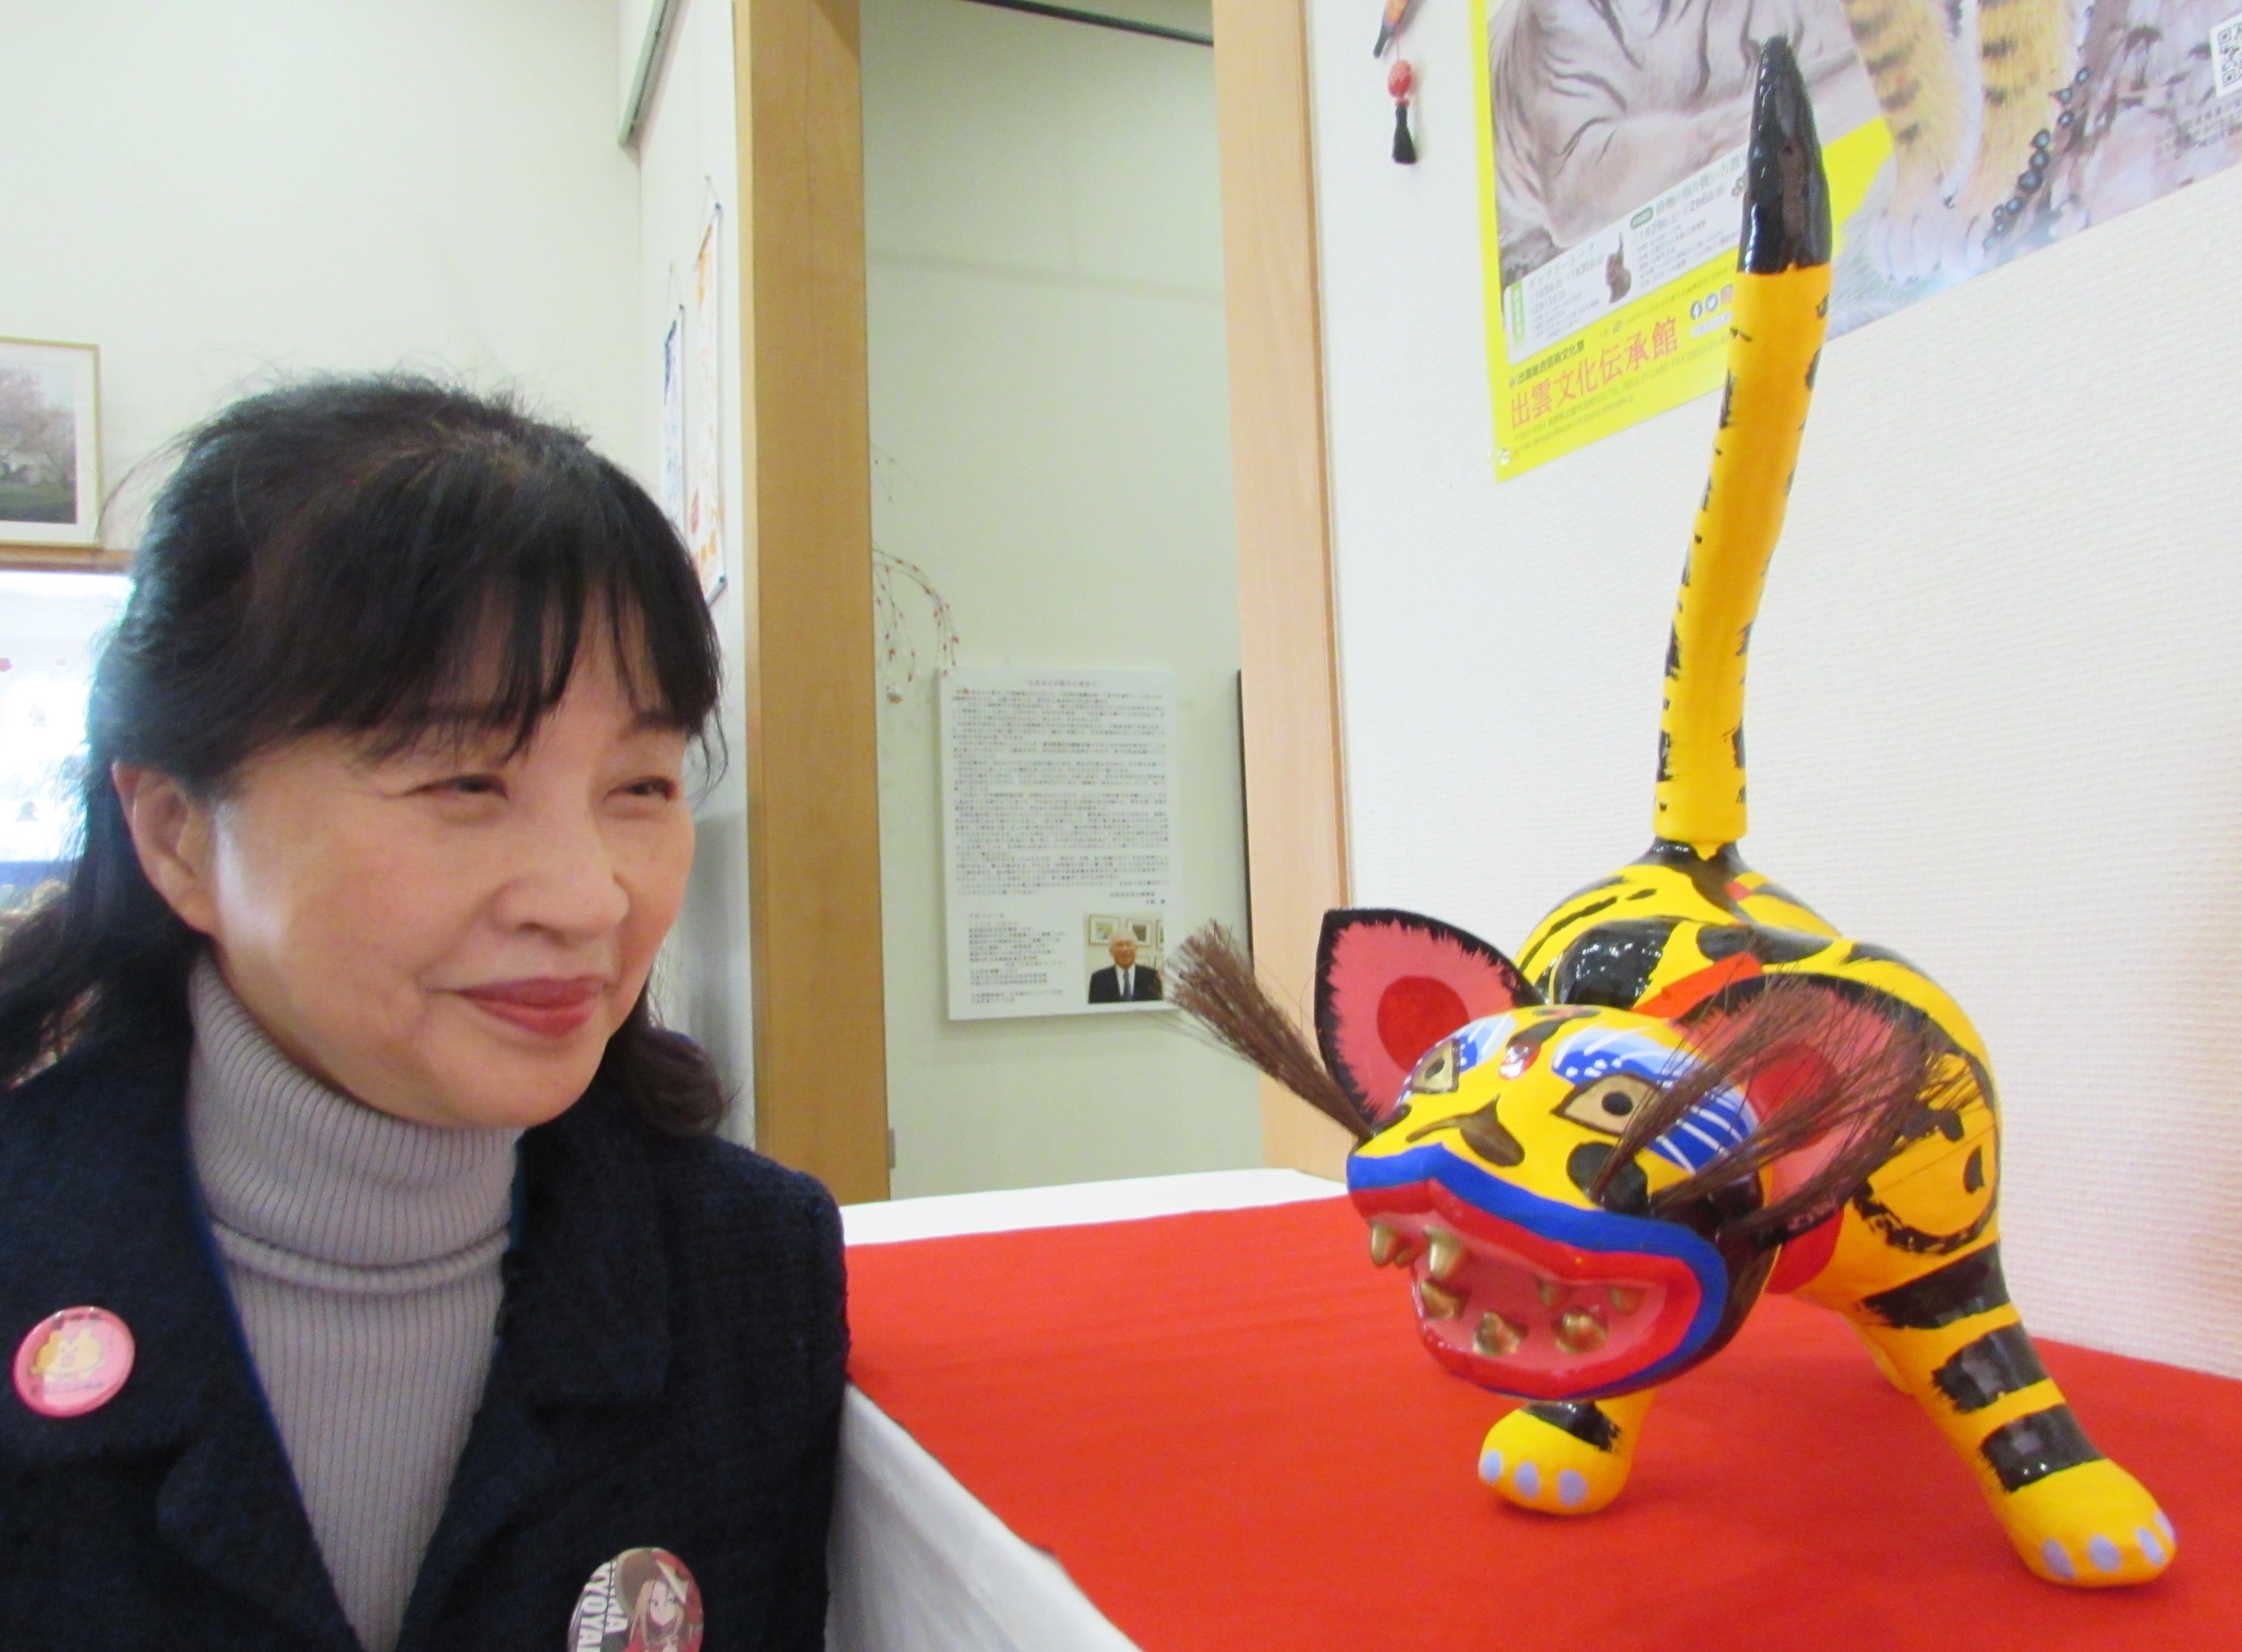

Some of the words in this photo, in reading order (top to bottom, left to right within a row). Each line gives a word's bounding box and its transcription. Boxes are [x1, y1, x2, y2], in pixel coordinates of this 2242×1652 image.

[1511, 315, 1678, 430] 出雲文化伝承館
